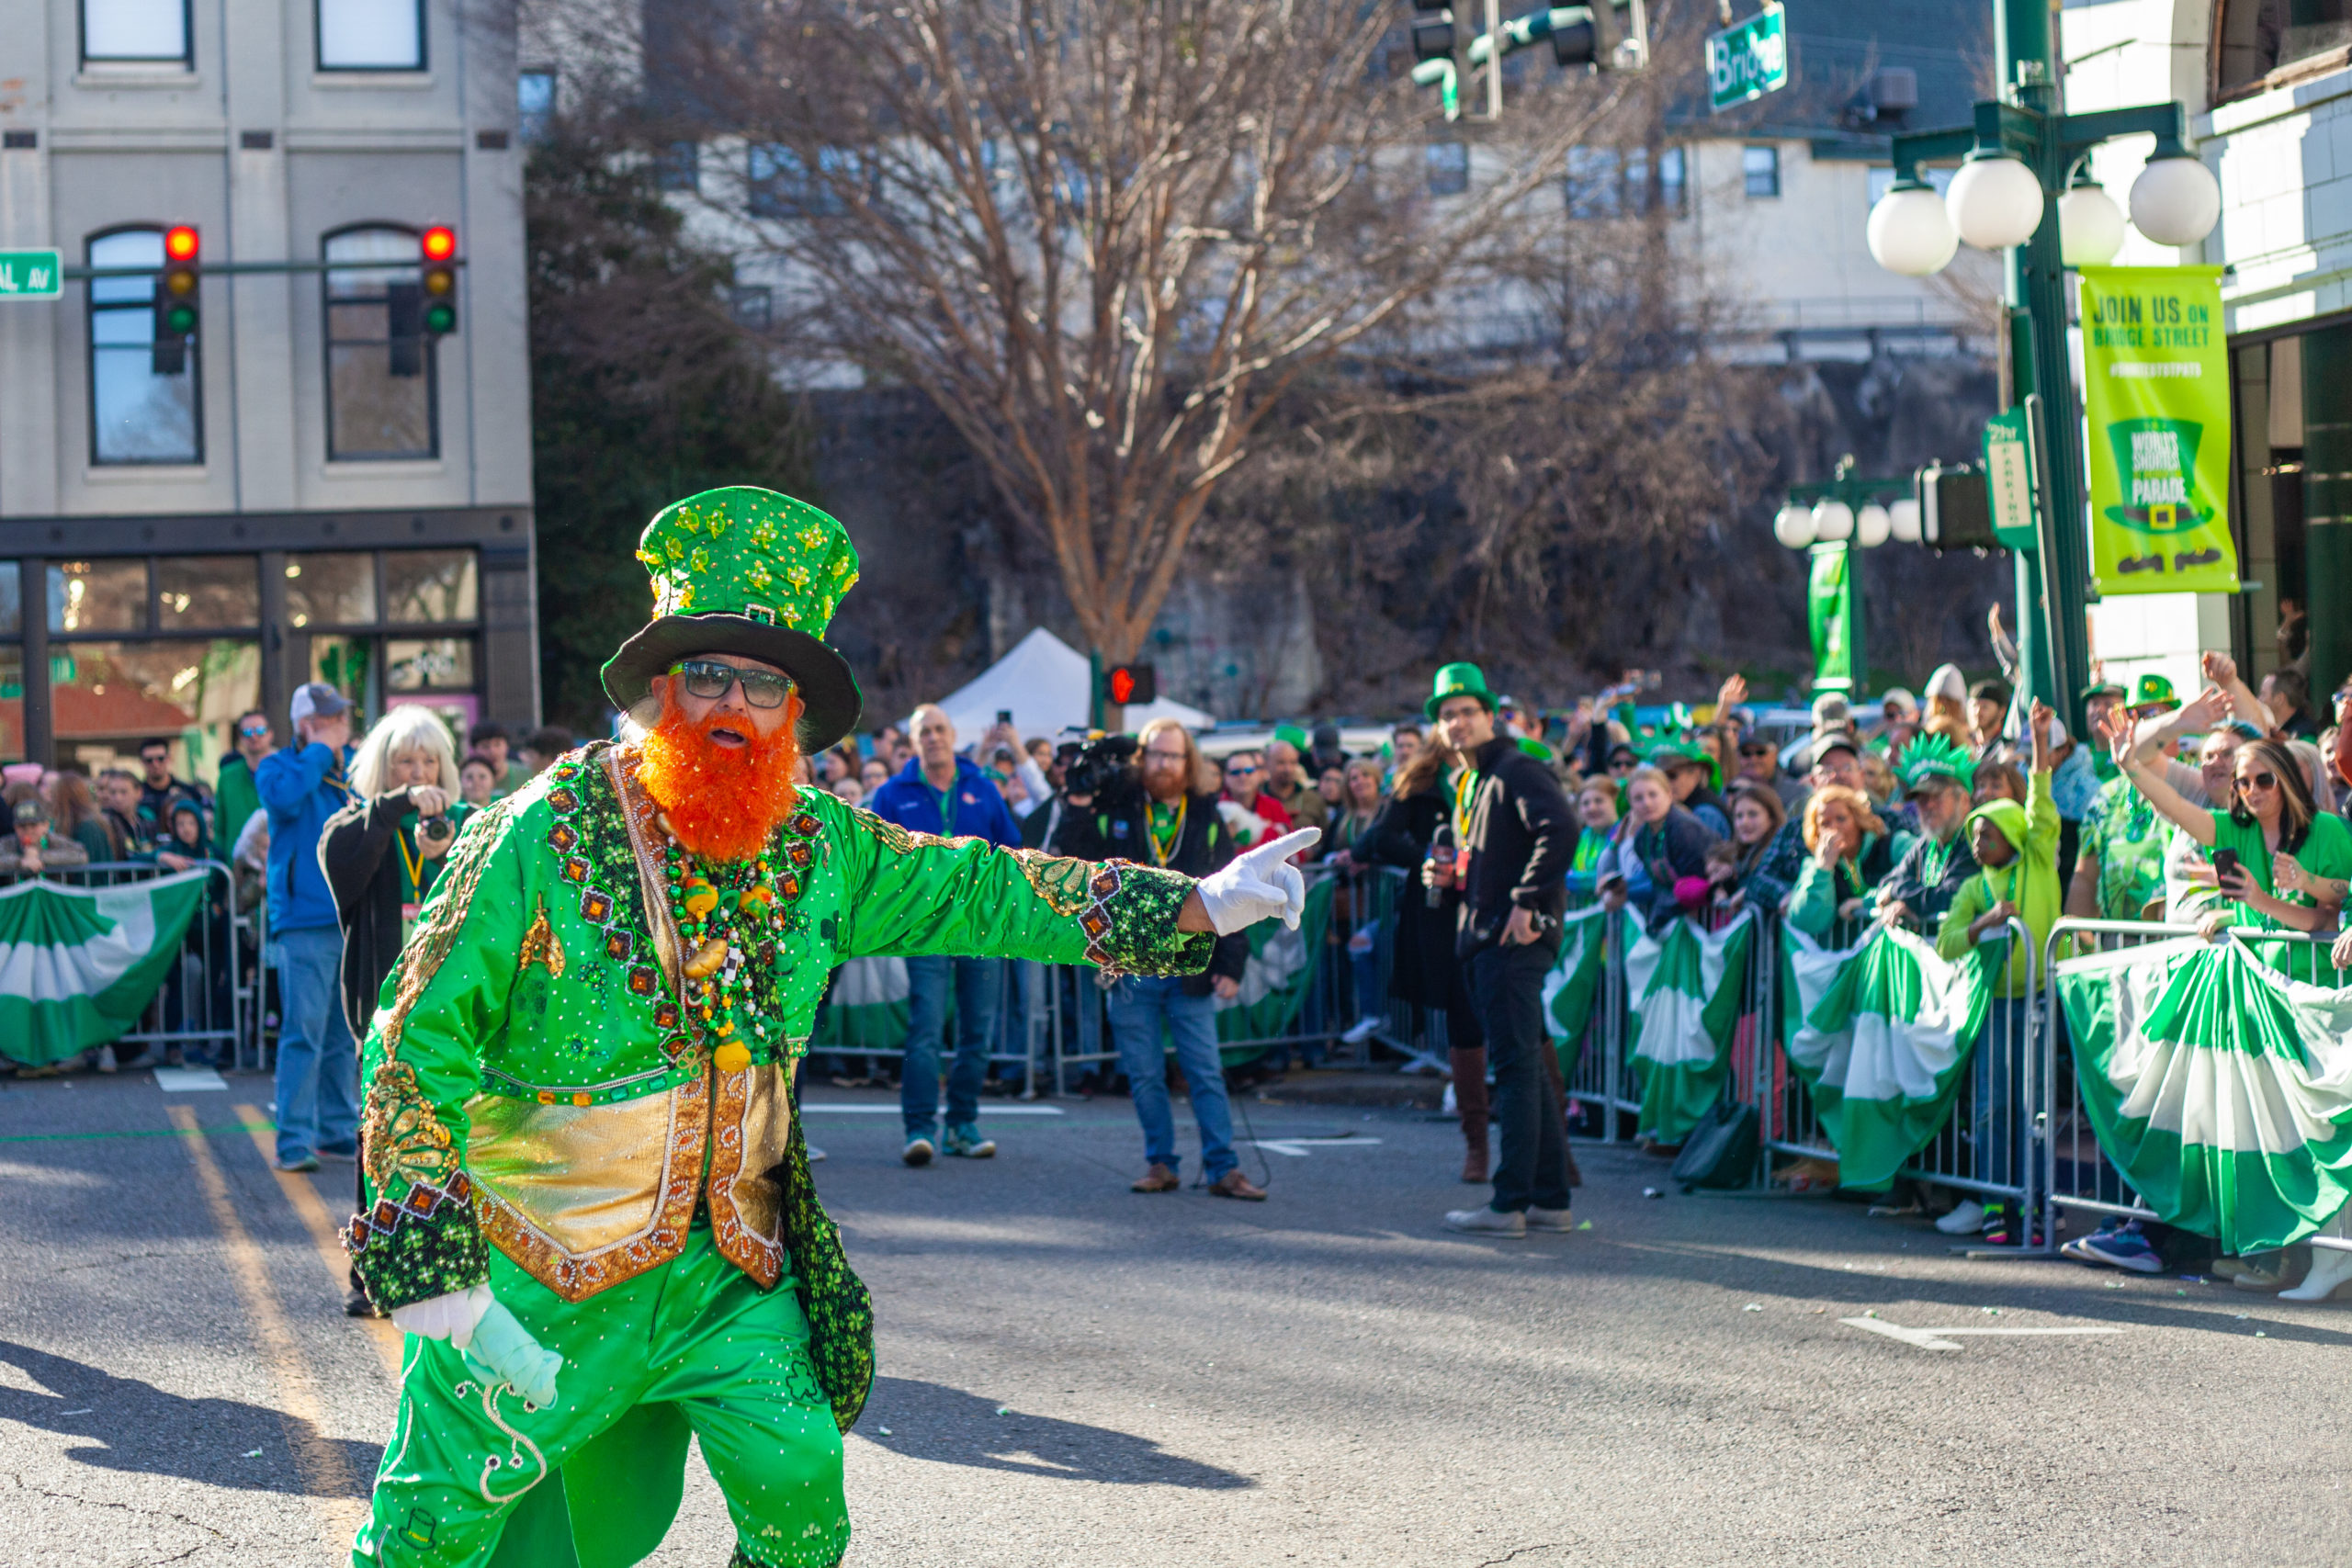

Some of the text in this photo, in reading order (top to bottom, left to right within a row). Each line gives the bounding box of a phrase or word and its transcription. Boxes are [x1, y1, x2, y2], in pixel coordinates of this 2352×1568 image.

[28, 267, 51, 289] AV
[2094, 296, 2209, 324] JOIN US ON
[2094, 326, 2210, 348] BRIDGE STREET
[2132, 477, 2188, 506] PARADE
